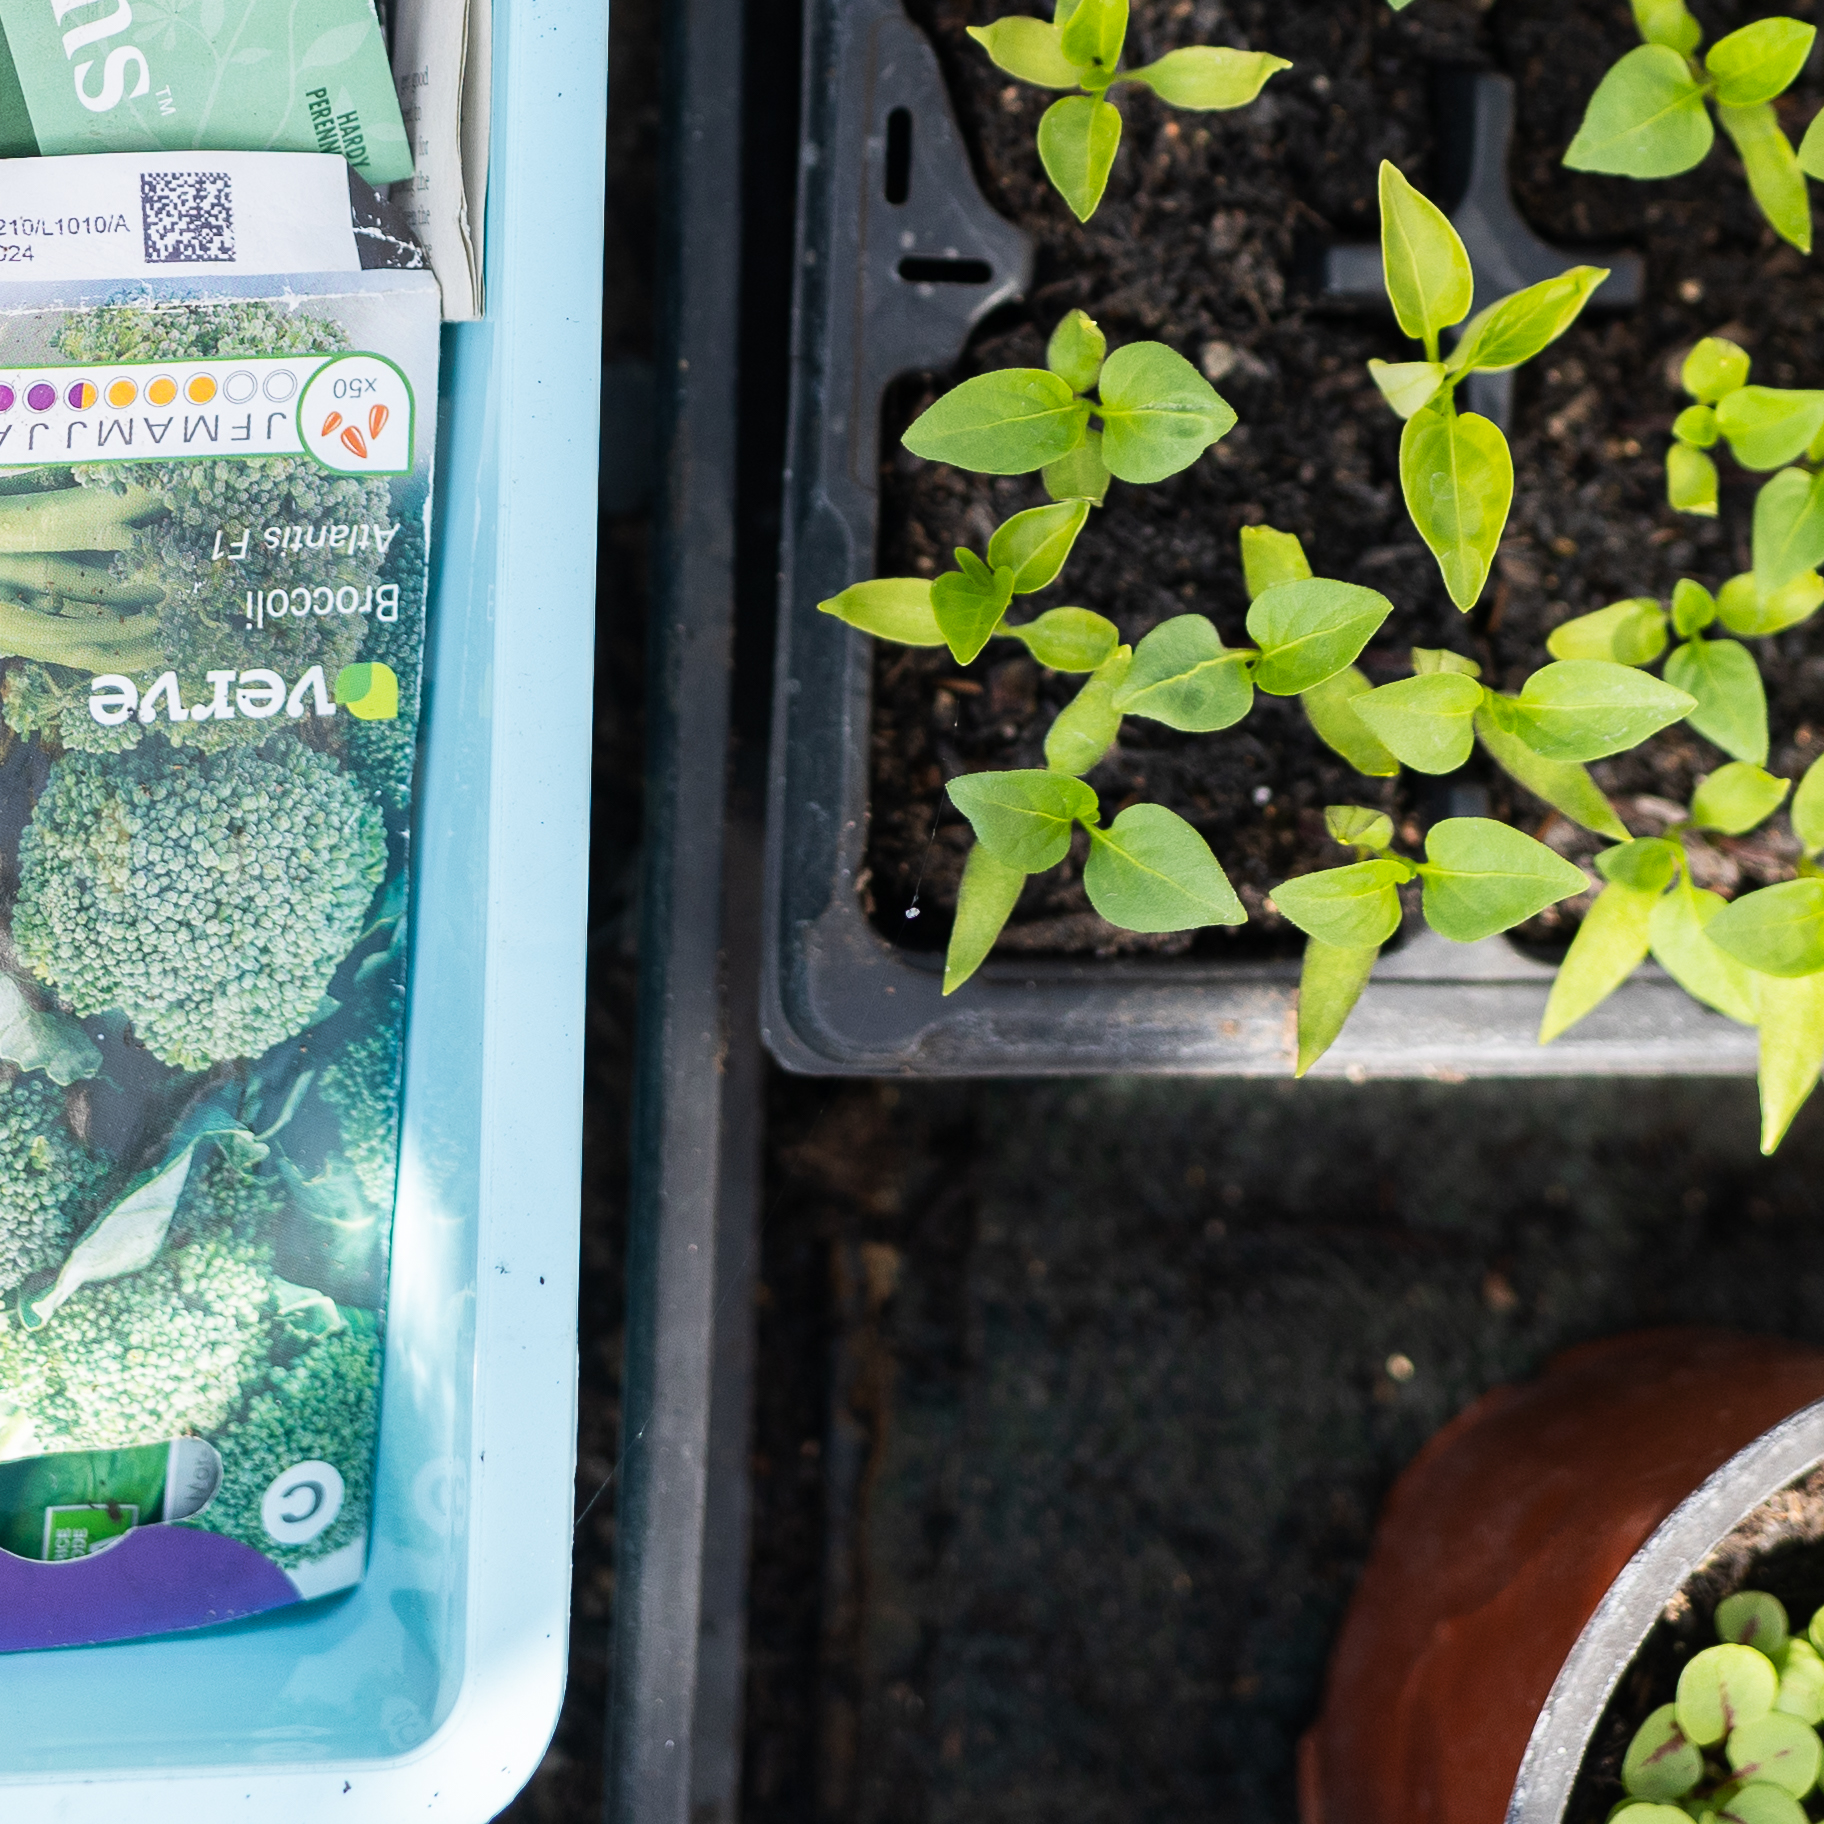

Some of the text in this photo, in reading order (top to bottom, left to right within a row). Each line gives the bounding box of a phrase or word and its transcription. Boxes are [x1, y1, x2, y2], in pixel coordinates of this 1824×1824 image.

[333, 108, 372, 172] HARDY
[211, 523, 401, 560] Atlantis F1
[245, 582, 400, 629] Broccoli
[90, 667, 337, 725] verve
